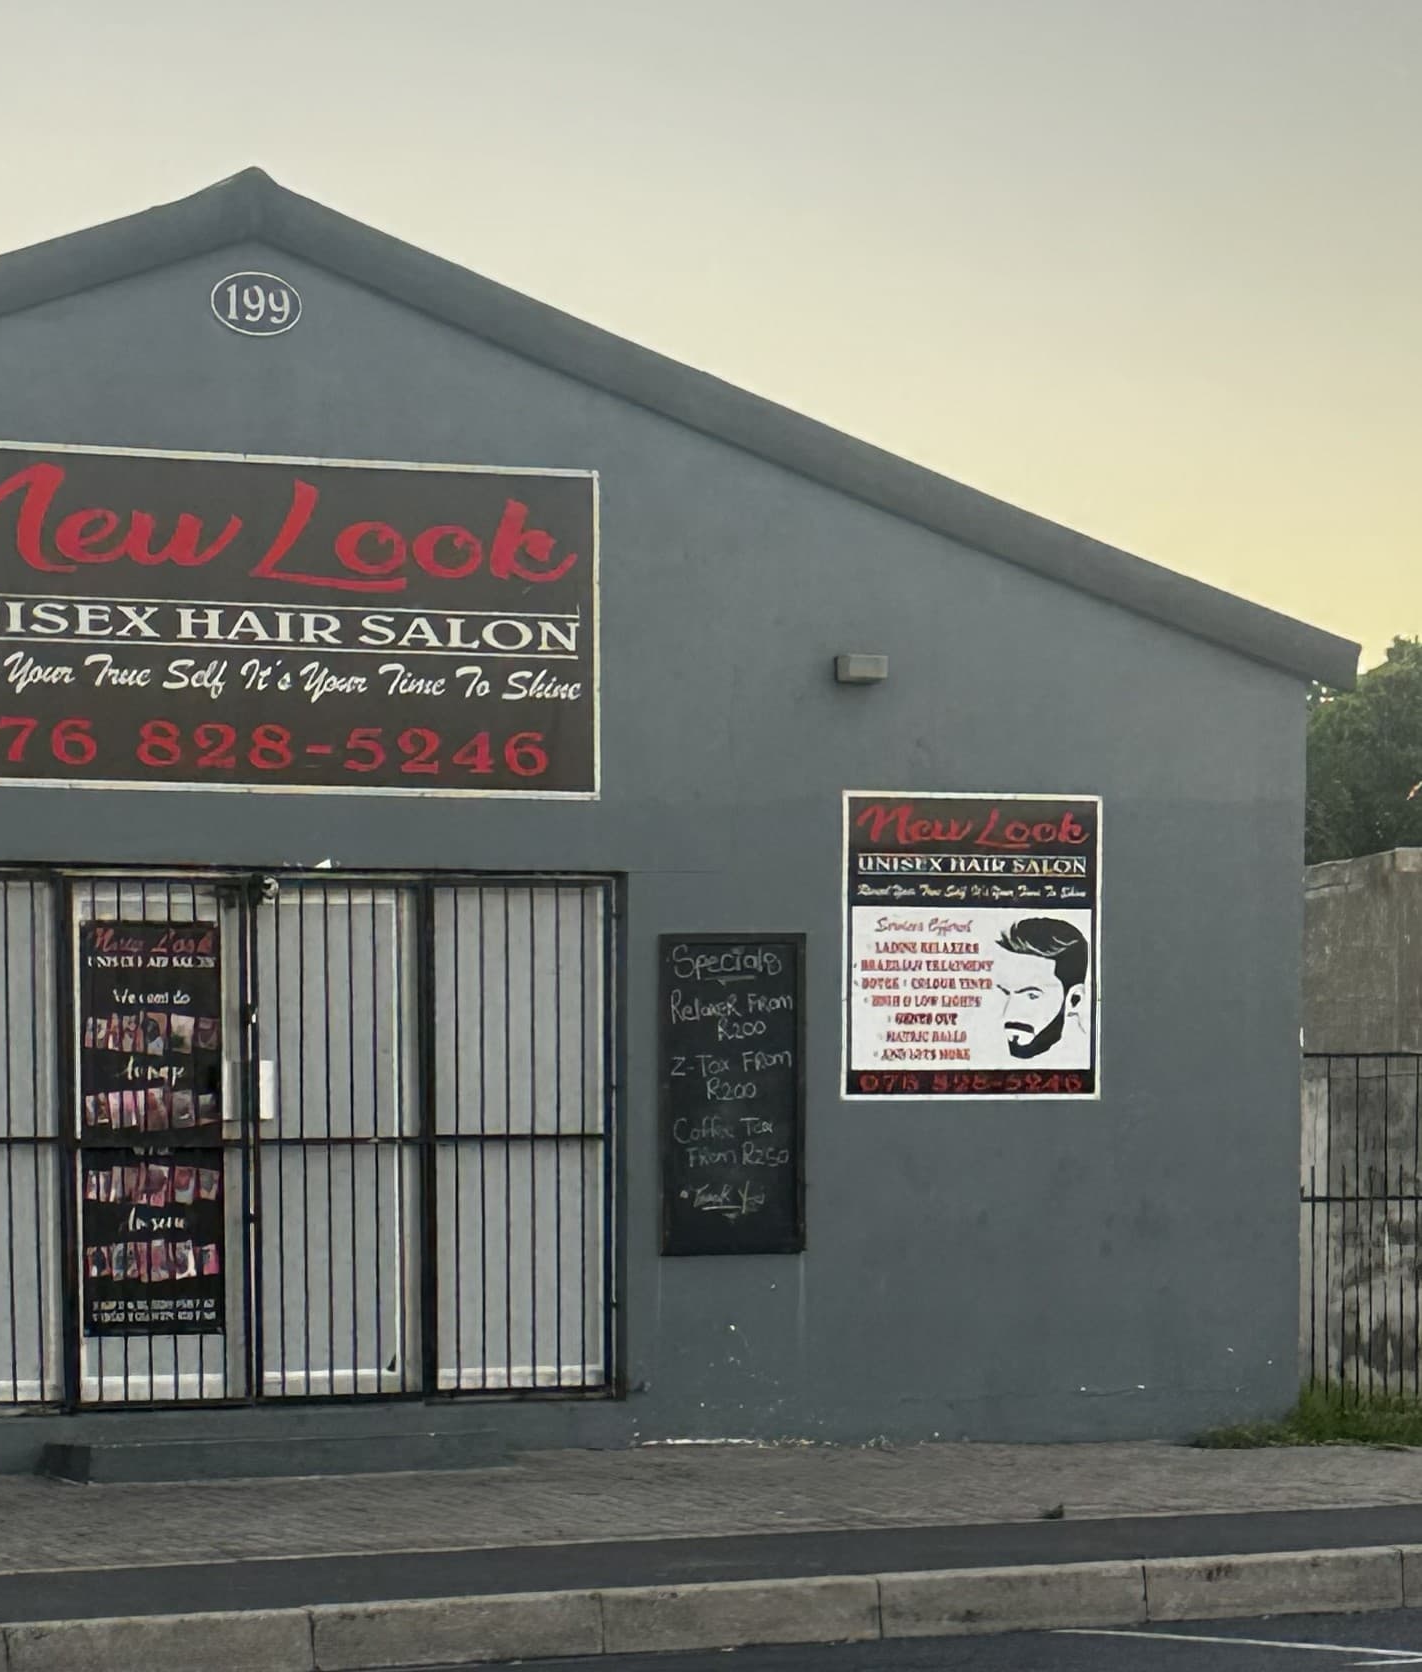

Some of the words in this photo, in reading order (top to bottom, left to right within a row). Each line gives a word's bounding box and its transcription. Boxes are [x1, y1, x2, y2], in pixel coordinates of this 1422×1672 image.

[227, 284, 290, 323] 199
[250, 478, 578, 592] Look
[177, 605, 342, 647] HAIR
[358, 612, 580, 653] SALON
[4, 651, 76, 689] Your
[85, 653, 152, 688] True
[162, 659, 226, 699] Self
[240, 659, 291, 690] It's
[298, 662, 368, 703] Your
[379, 664, 446, 697] Time
[456, 666, 491, 698] To
[501, 671, 582, 701] Shine
[137, 721, 550, 777] 828-5246
[857, 804, 973, 845] New
[974, 807, 1090, 848] Look
[859, 856, 942, 872] UNISEX
[950, 857, 1006, 873] HAIR
[1012, 858, 1086, 874] SALON
[673, 944, 782, 981] Specials
[717, 1017, 766, 1042] R200
[707, 1077, 756, 1101] R200
